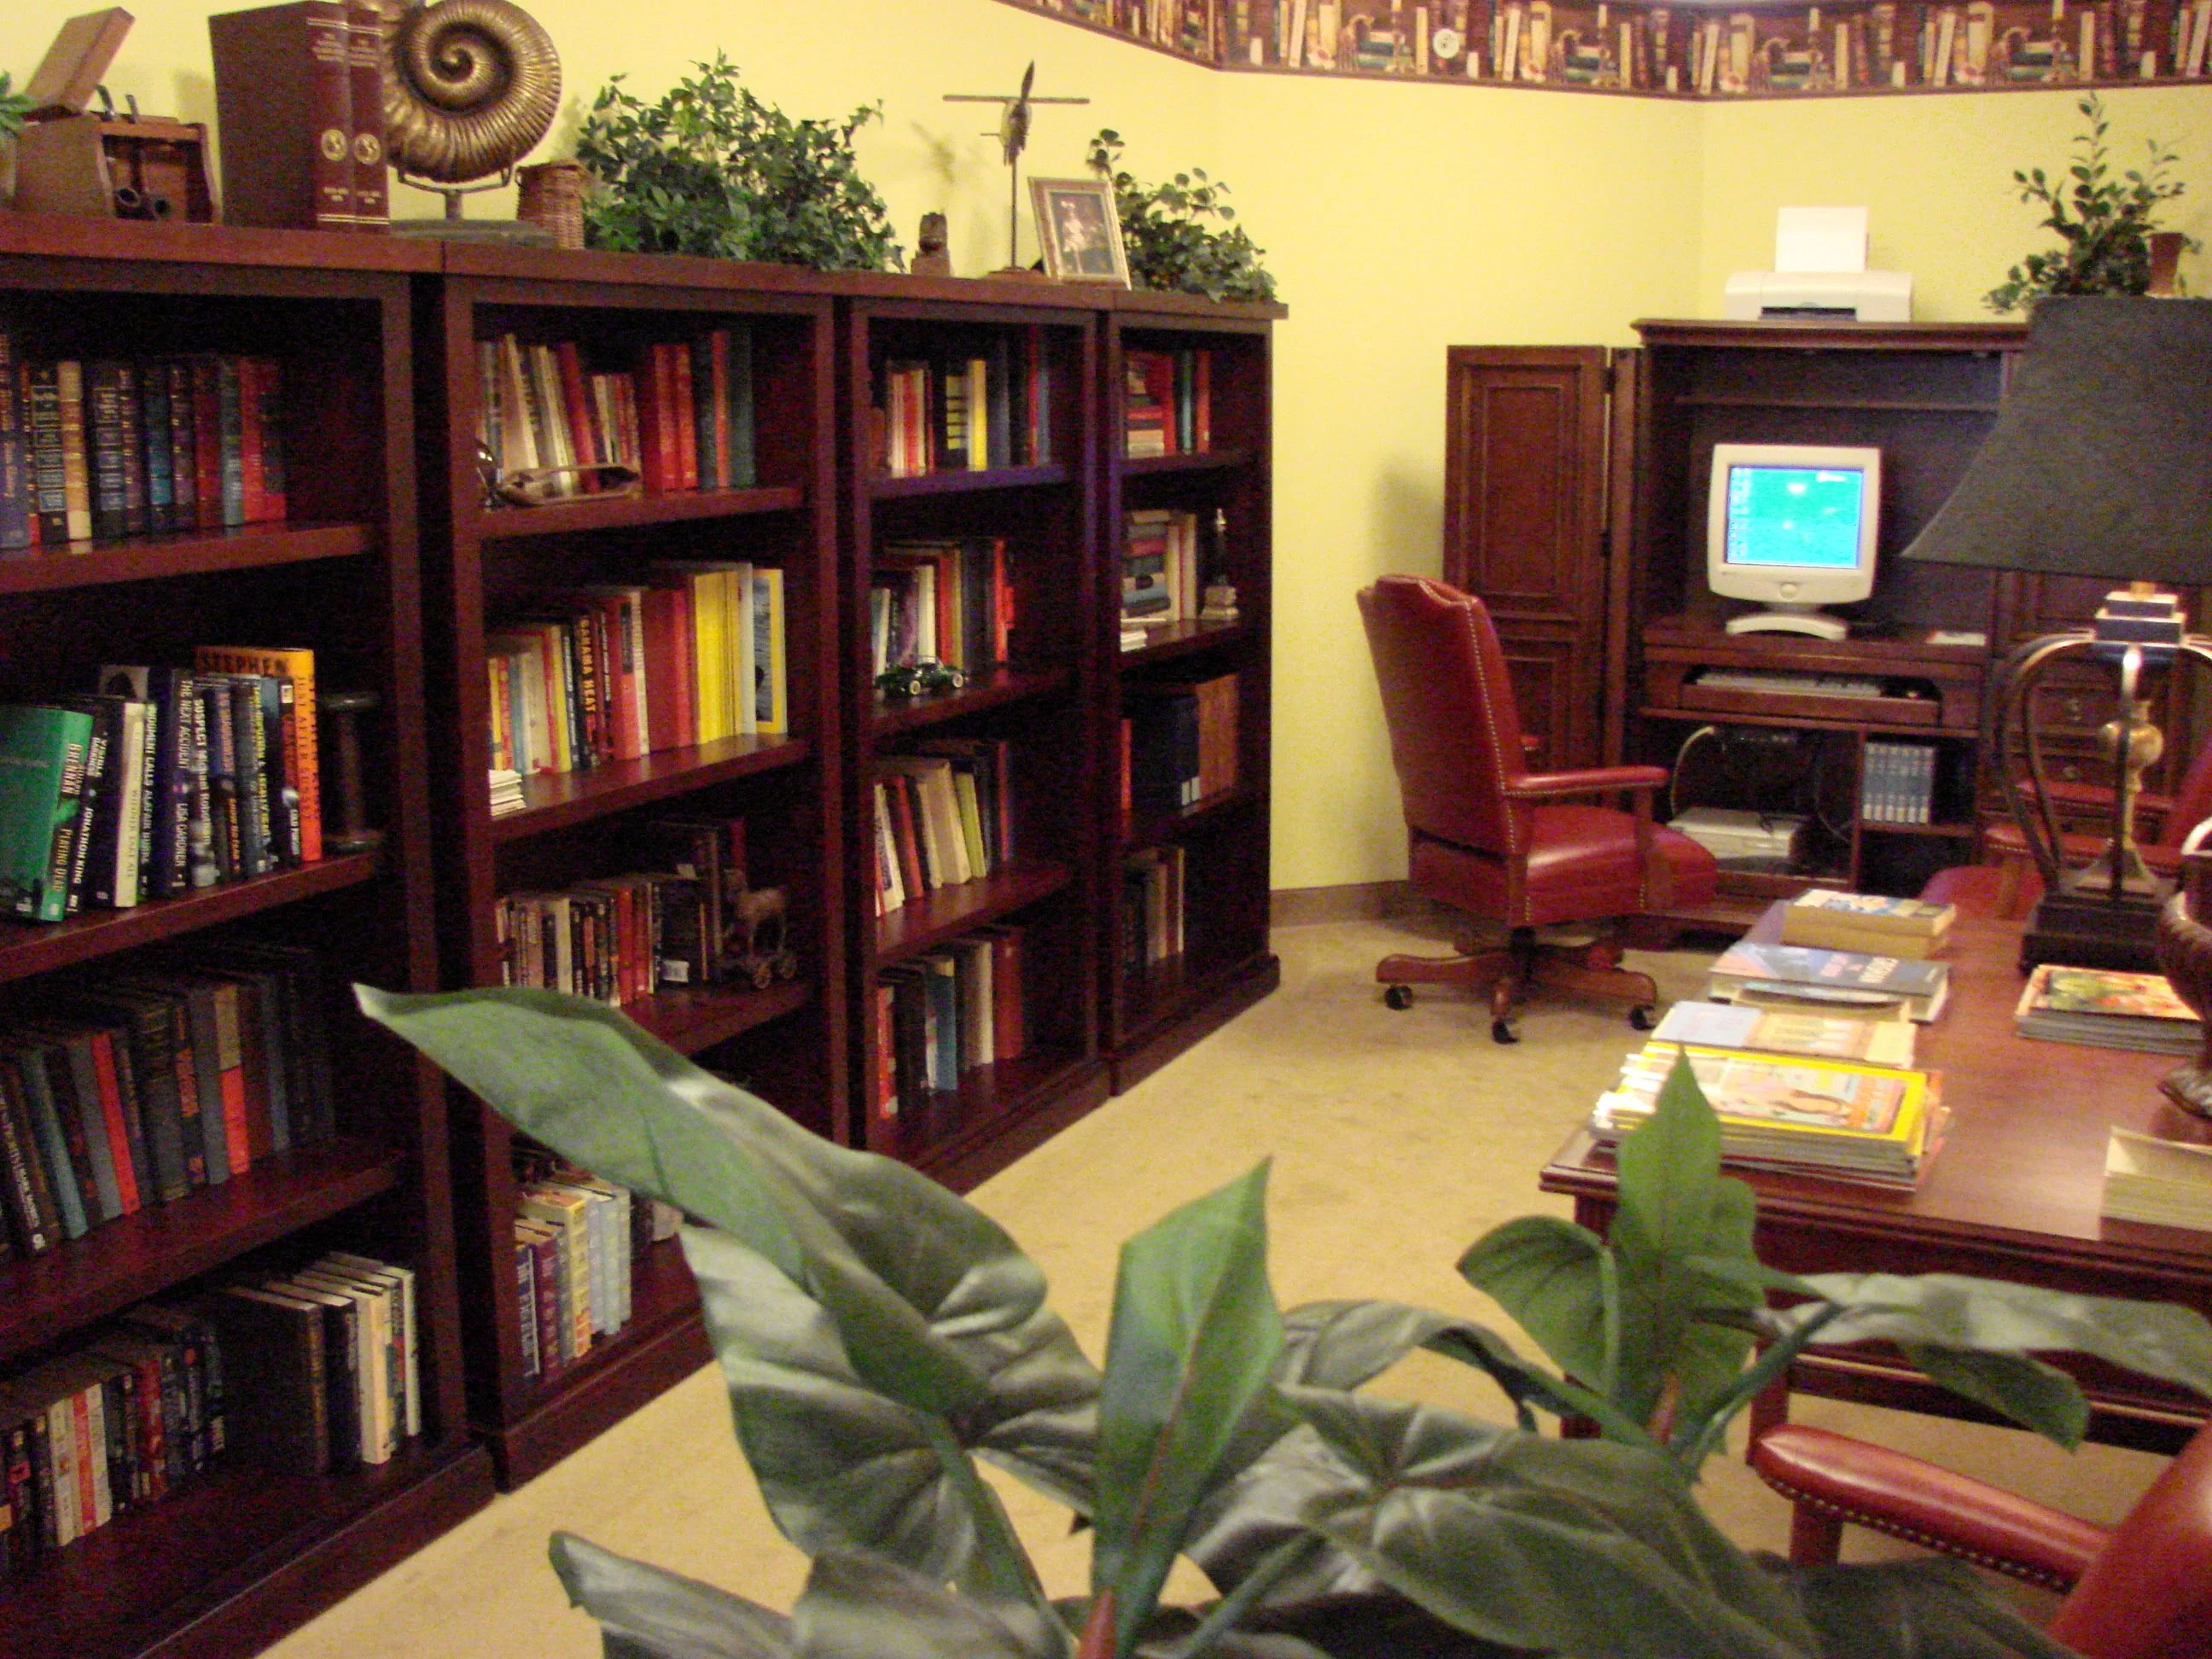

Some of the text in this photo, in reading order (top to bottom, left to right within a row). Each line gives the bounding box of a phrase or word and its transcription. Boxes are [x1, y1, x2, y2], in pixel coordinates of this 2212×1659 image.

[584, 680, 596, 712] HEAT
[178, 680, 193, 768] THE NEXT ACCIDENT
[194, 698, 207, 747] SUSPECT
[176, 803, 189, 822] LISA
[55, 829, 73, 865] PLAYING
[73, 806, 94, 883] JONATHON KING
